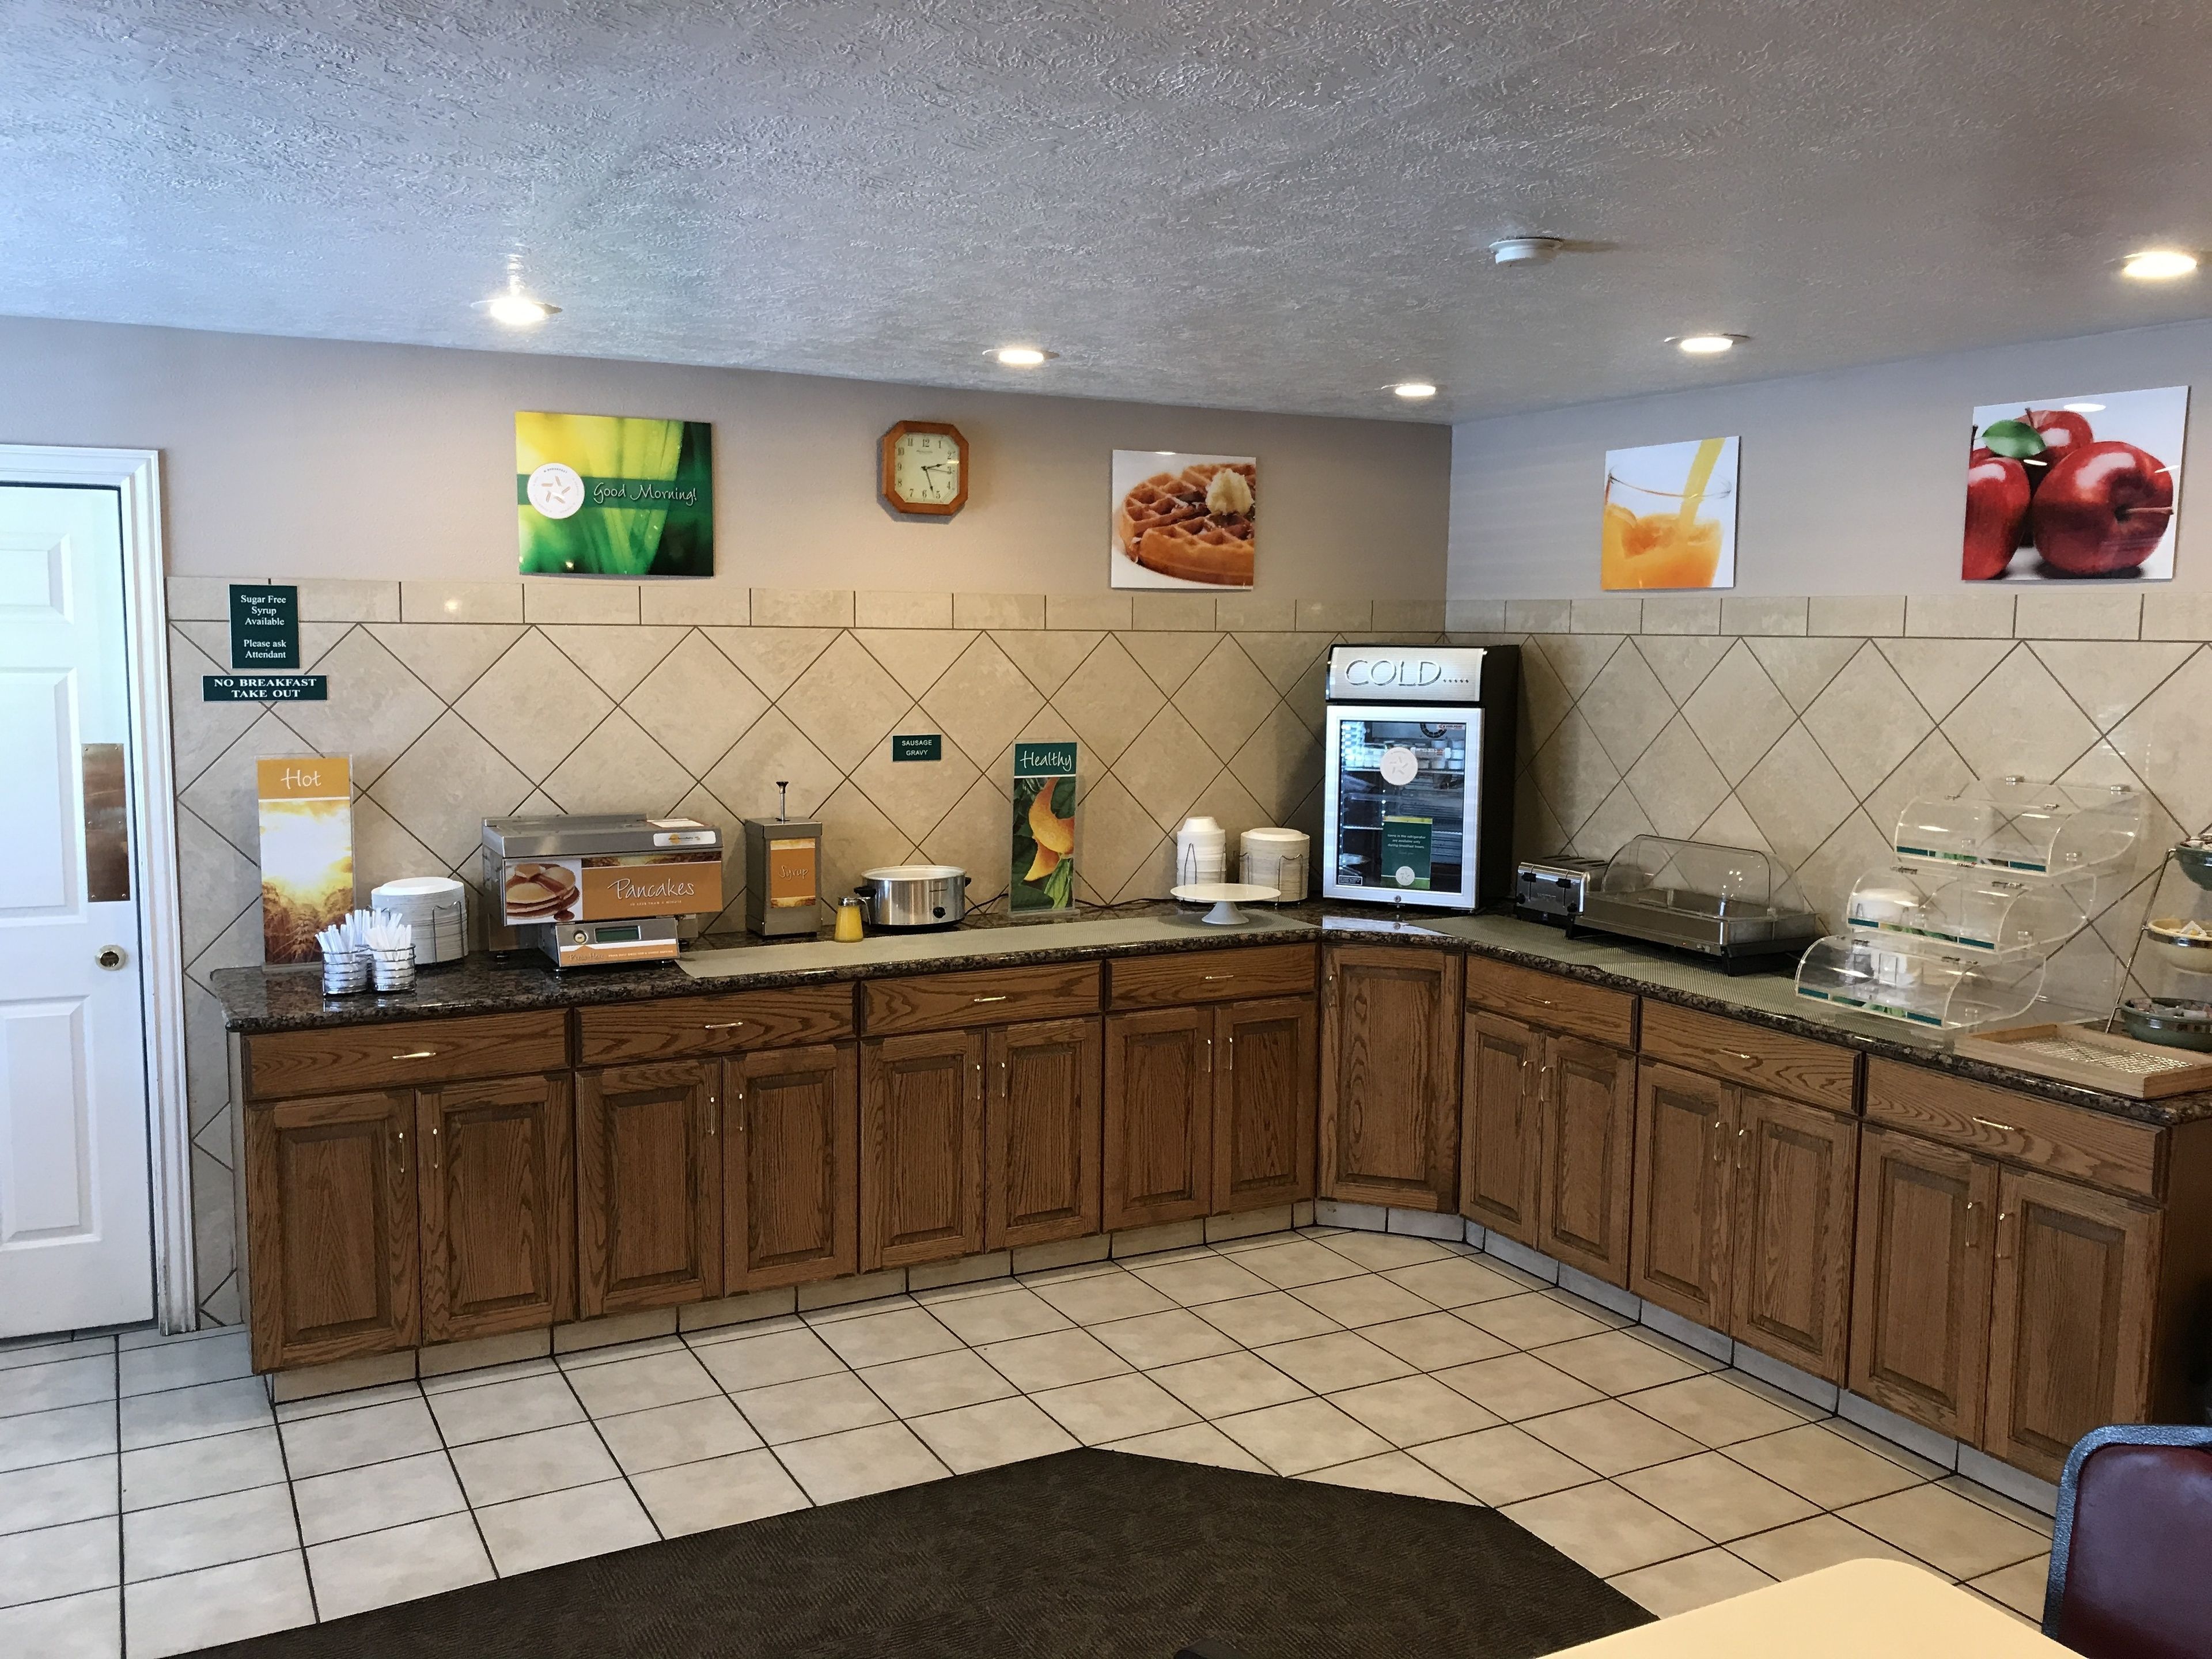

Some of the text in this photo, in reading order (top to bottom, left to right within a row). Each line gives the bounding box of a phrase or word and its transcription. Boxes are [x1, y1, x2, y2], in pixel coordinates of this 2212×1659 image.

[908, 438, 913, 446] 11
[922, 439, 930, 447] 12
[947, 452, 952, 460] 2
[947, 482, 950, 490] 4
[593, 482, 626, 504] Good
[630, 484, 697, 506] Morning!
[909, 488, 914, 497] 7
[935, 491, 940, 499] 5
[241, 595, 286, 604] Sugar Free
[251, 607, 276, 616] Syrup
[244, 618, 285, 626] Available
[244, 639, 286, 647] Please ask
[214, 679, 317, 687] NO BREAKFAST
[273, 690, 301, 698] OUT
[1020, 751, 1072, 772] Healthy
[281, 767, 321, 790] Hot
[779, 866, 809, 881] Syrup
[607, 878, 694, 899] Pancakes
